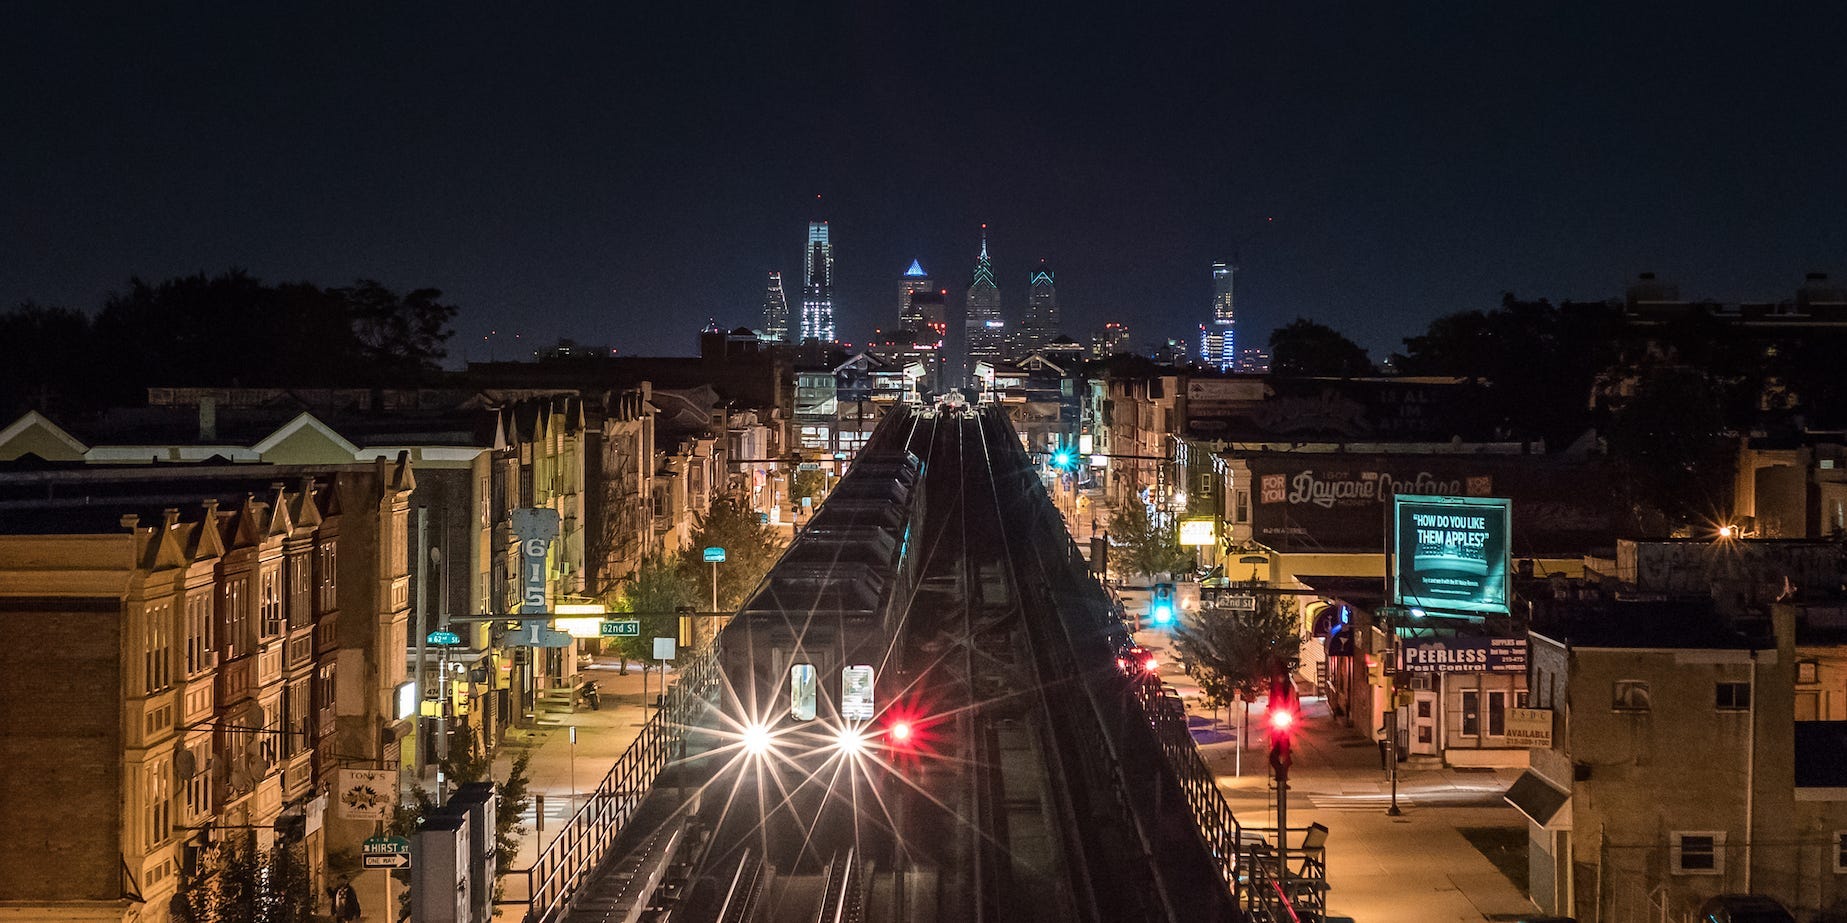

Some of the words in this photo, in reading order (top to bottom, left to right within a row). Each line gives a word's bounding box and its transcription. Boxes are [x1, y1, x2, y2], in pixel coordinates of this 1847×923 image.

[1263, 477, 1285, 489] FOR
[1261, 489, 1286, 502] YOU
[1413, 514, 1436, 527] “HOW
[1437, 516, 1449, 528] DO
[1449, 516, 1467, 529] YOU
[1468, 517, 1485, 529] LIKE
[1417, 529, 1444, 544] THEM
[1445, 531, 1489, 547] APPLES?”
[1220, 598, 1241, 607] 62nd
[602, 624, 624, 633] 62nd
[627, 624, 636, 633] St
[1406, 648, 1487, 663] PEERLESS
[1505, 729, 1550, 739] AVAILABLE
[371, 843, 398, 853] HIRST
